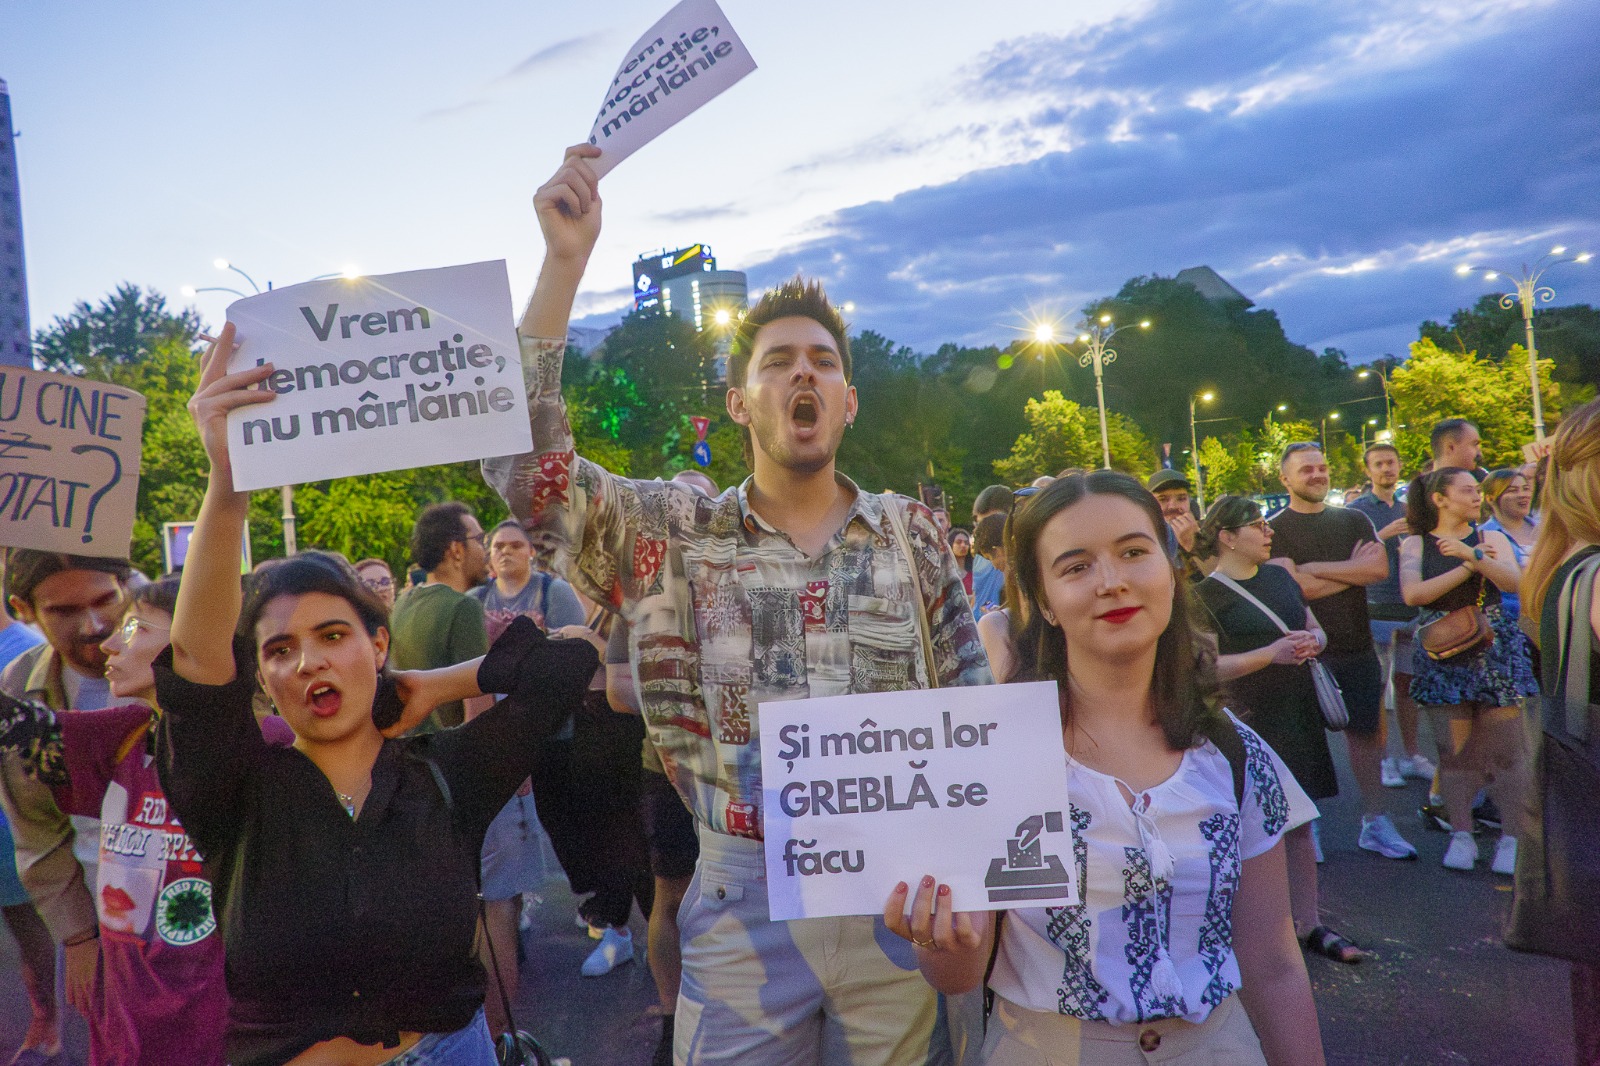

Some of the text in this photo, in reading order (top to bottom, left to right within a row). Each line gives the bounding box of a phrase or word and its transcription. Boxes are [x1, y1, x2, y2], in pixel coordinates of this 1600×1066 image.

[594, 26, 719, 126] mocrație,
[602, 40, 732, 137] mârlănie
[614, 37, 664, 86] rem
[300, 303, 430, 341] Vrem
[0, 373, 129, 441] U CINE
[243, 376, 514, 445] nu mârlănie
[0, 444, 122, 543] OTAT?
[778, 711, 998, 774] Și mâna lor
[780, 760, 988, 817] GREBLĂ se
[782, 839, 865, 876] făcu
[193, 881, 212, 901] HO
